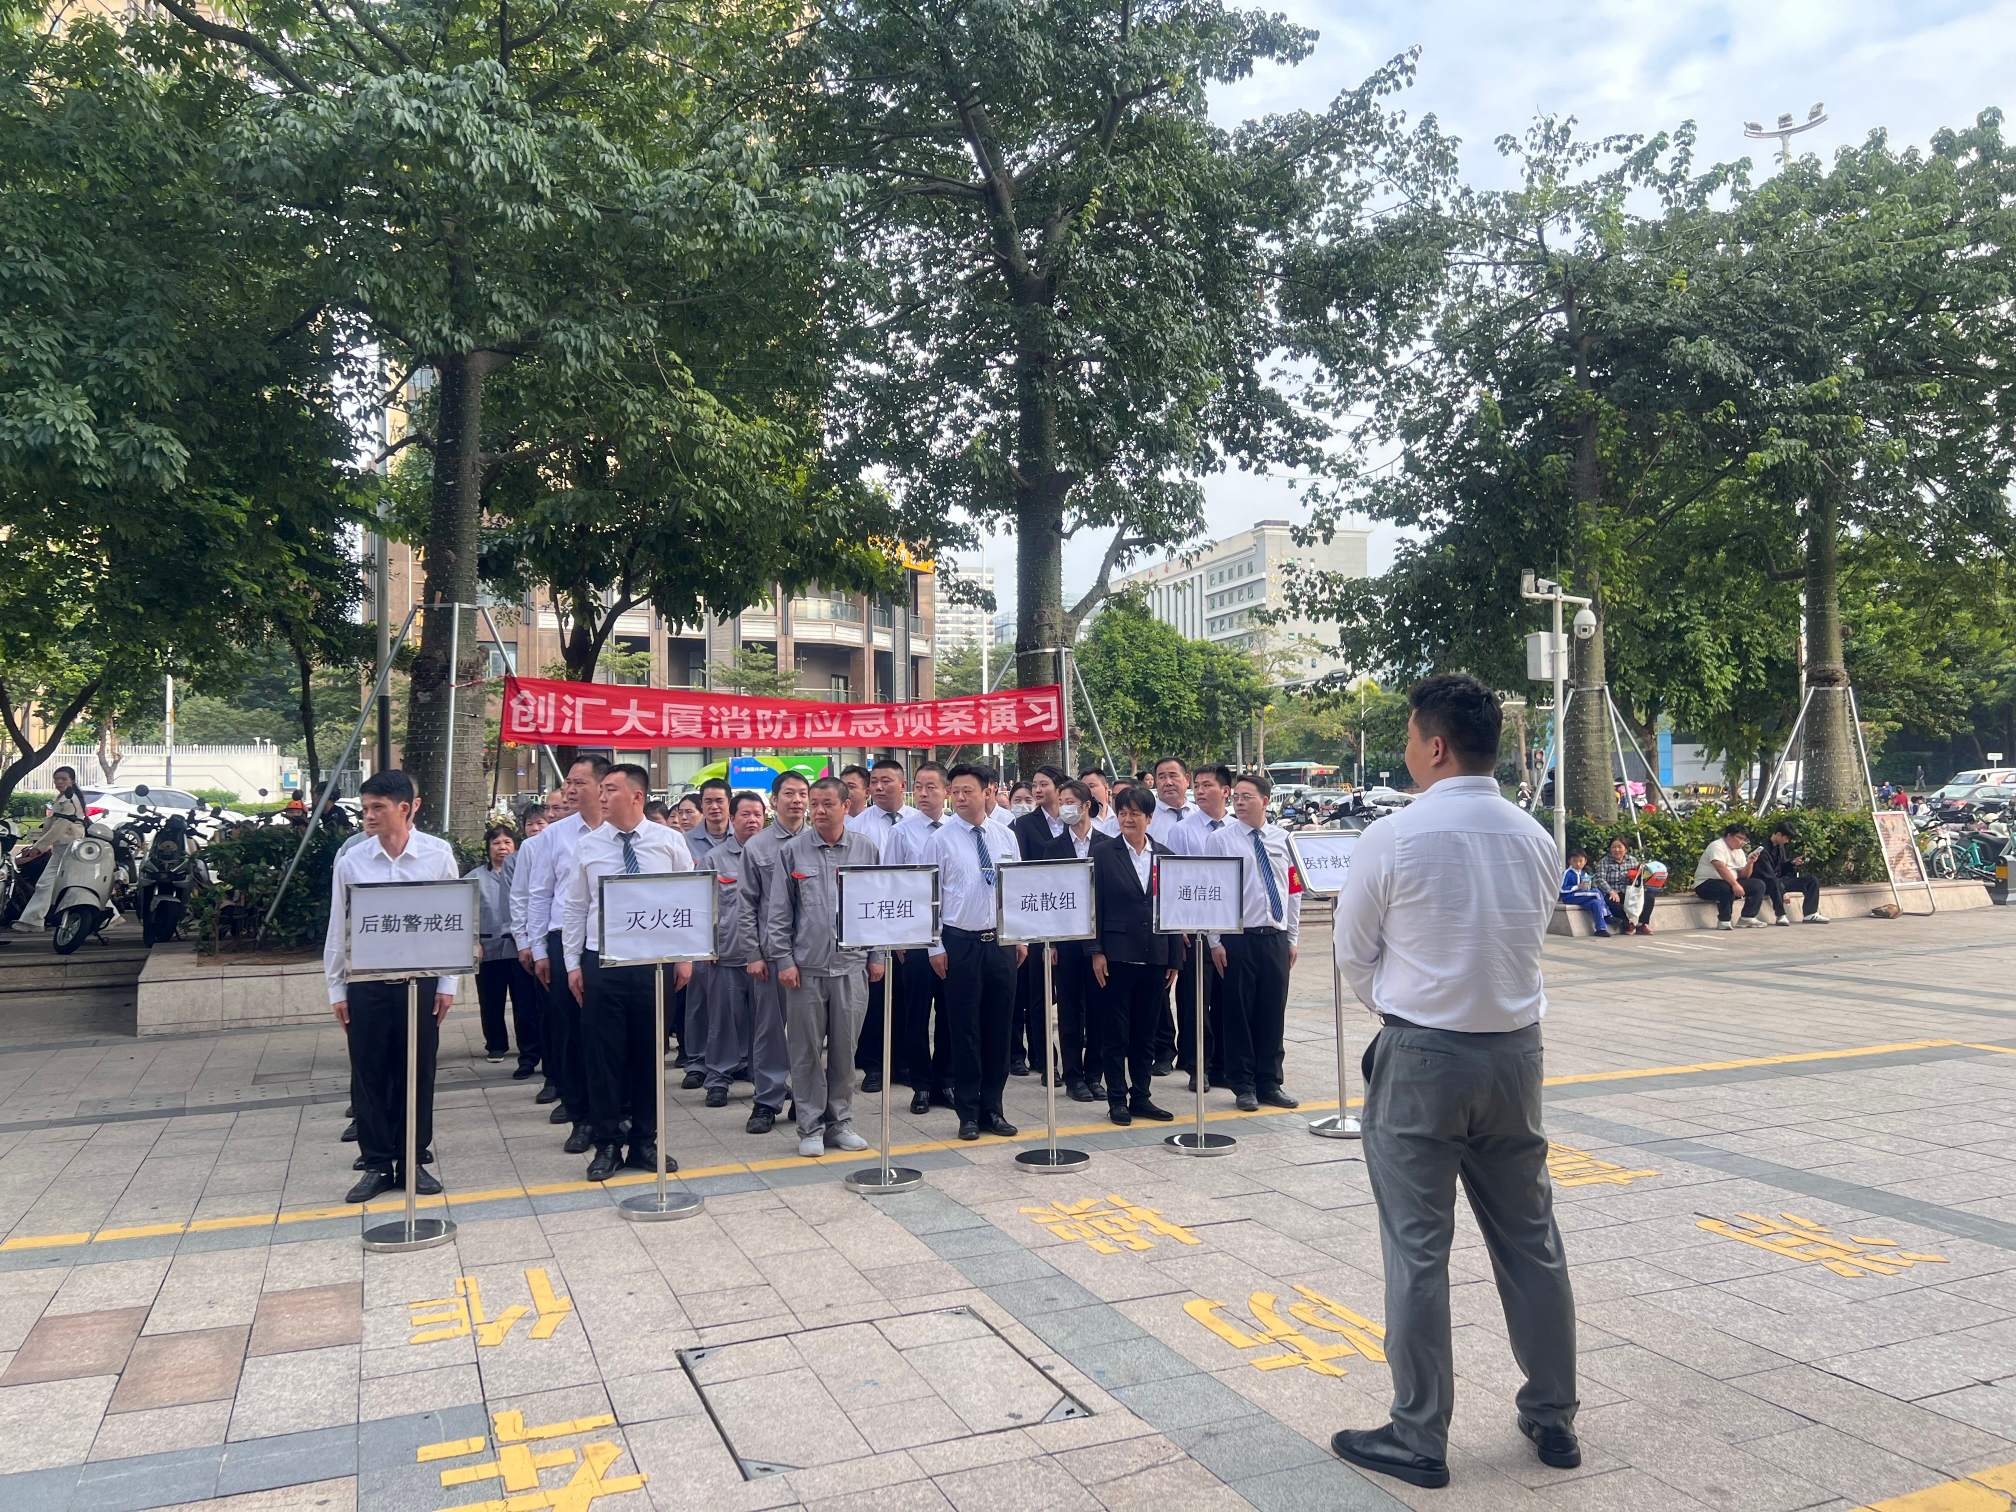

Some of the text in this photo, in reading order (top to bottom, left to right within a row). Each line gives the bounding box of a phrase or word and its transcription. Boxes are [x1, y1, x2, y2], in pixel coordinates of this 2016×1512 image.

[507, 690, 1058, 739] 创汇大厦消防应急预案演习
[1020, 890, 1077, 912] 疏散组
[1177, 885, 1222, 904] 通信组
[626, 907, 694, 931] 灭火组
[857, 899, 915, 921] 工程组
[359, 912, 465, 935] 后勤警戒组
